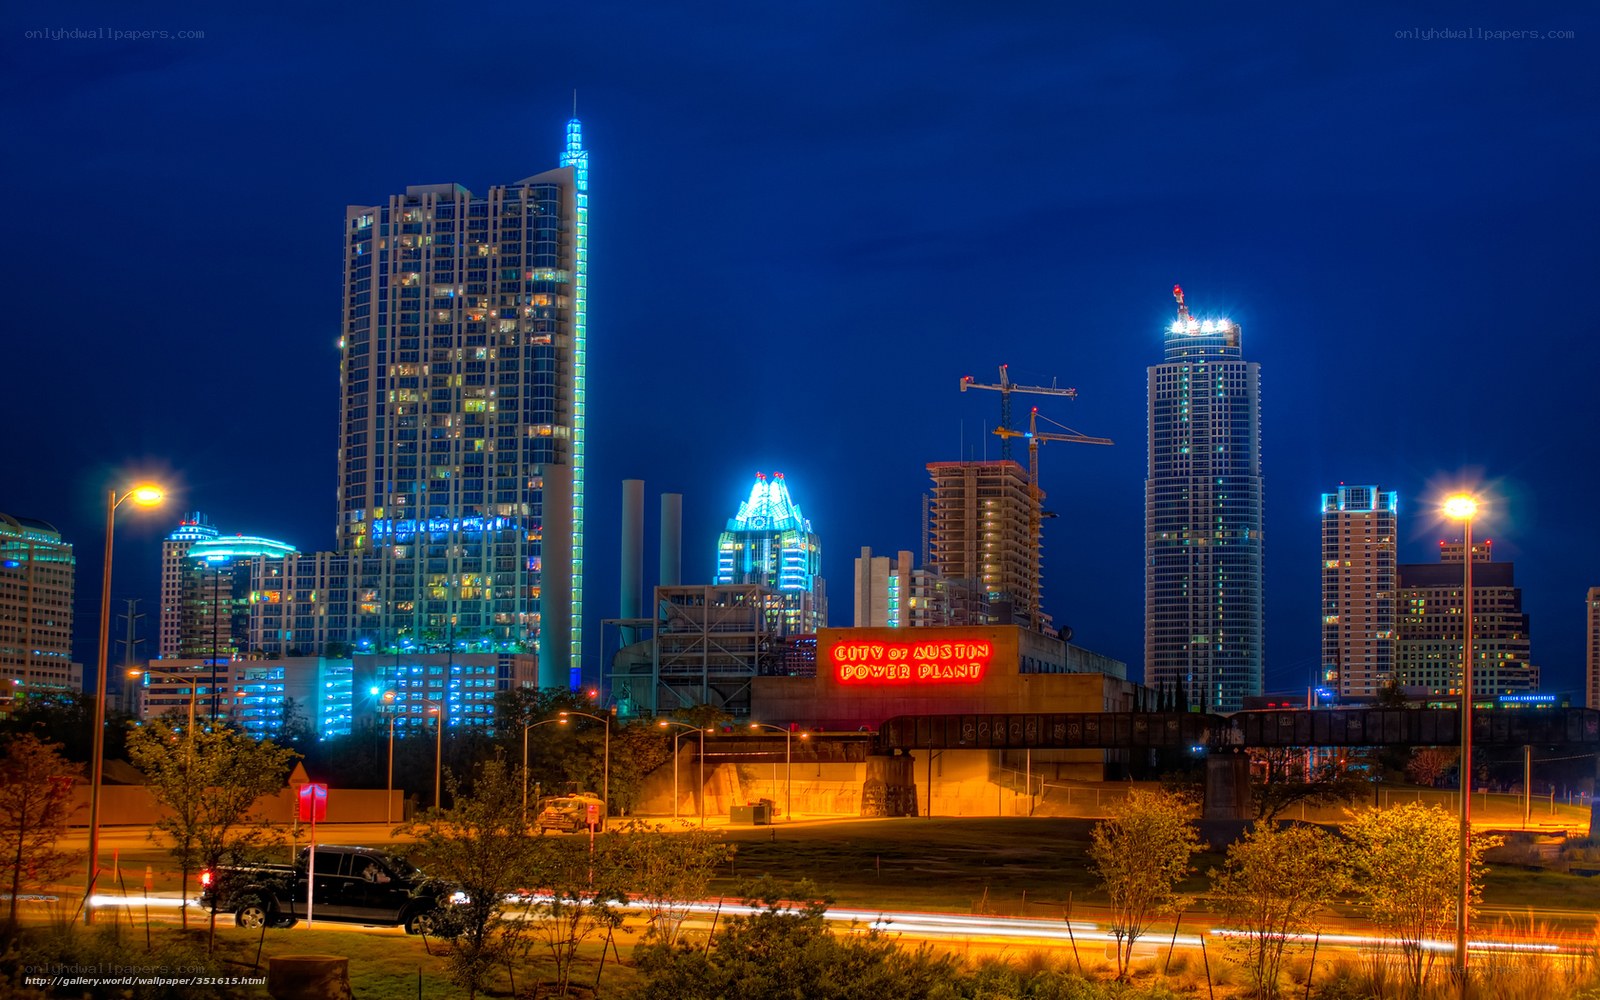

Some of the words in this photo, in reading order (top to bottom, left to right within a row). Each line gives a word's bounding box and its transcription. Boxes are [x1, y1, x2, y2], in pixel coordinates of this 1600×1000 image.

[834, 645, 884, 660] CITY
[913, 644, 989, 660] AUSTIN
[841, 664, 910, 680] POWER
[918, 662, 981, 679] PLANT
